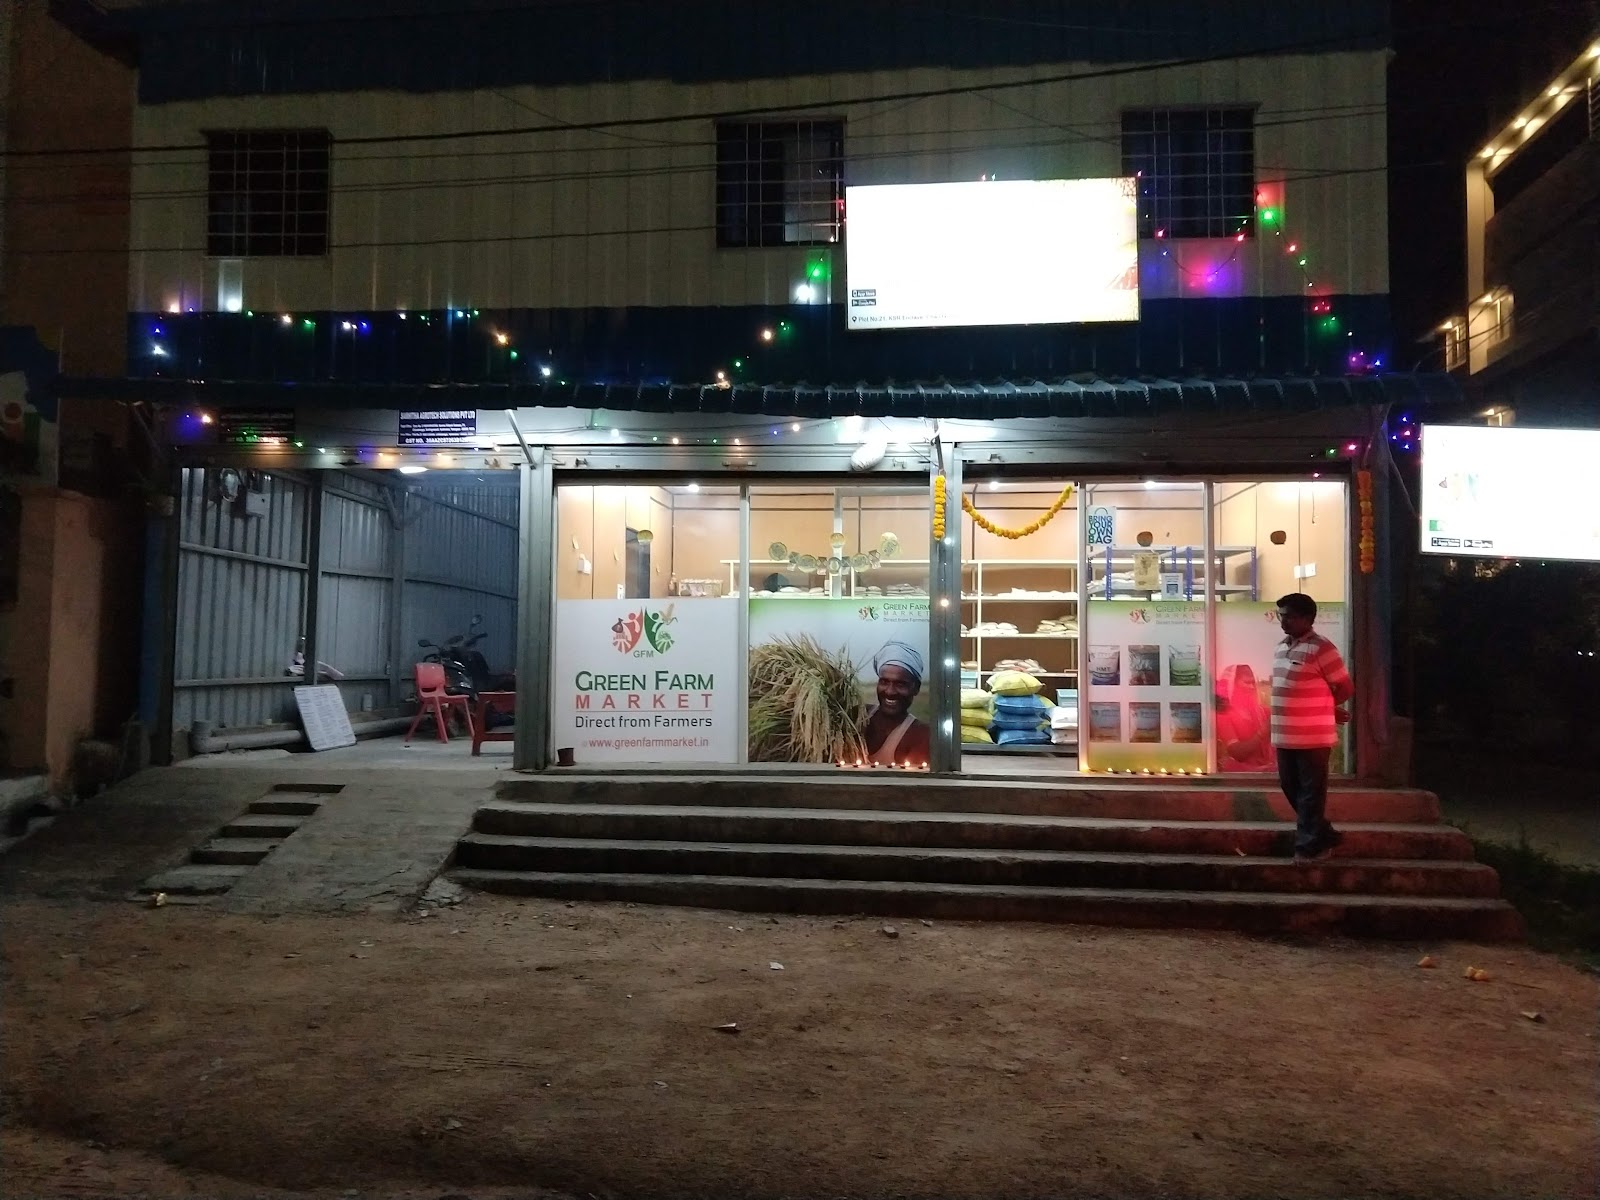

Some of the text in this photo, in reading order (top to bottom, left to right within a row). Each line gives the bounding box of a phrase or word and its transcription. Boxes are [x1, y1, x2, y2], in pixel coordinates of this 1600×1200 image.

[1088, 520, 1113, 528] YOUR
[1088, 526, 1113, 536] OWN
[1088, 534, 1113, 544] BAG
[633, 650, 654, 658] GFM
[575, 670, 714, 691] GREEN FARM
[575, 693, 713, 709] MARKET
[575, 715, 713, 728] Direct from Farmers
